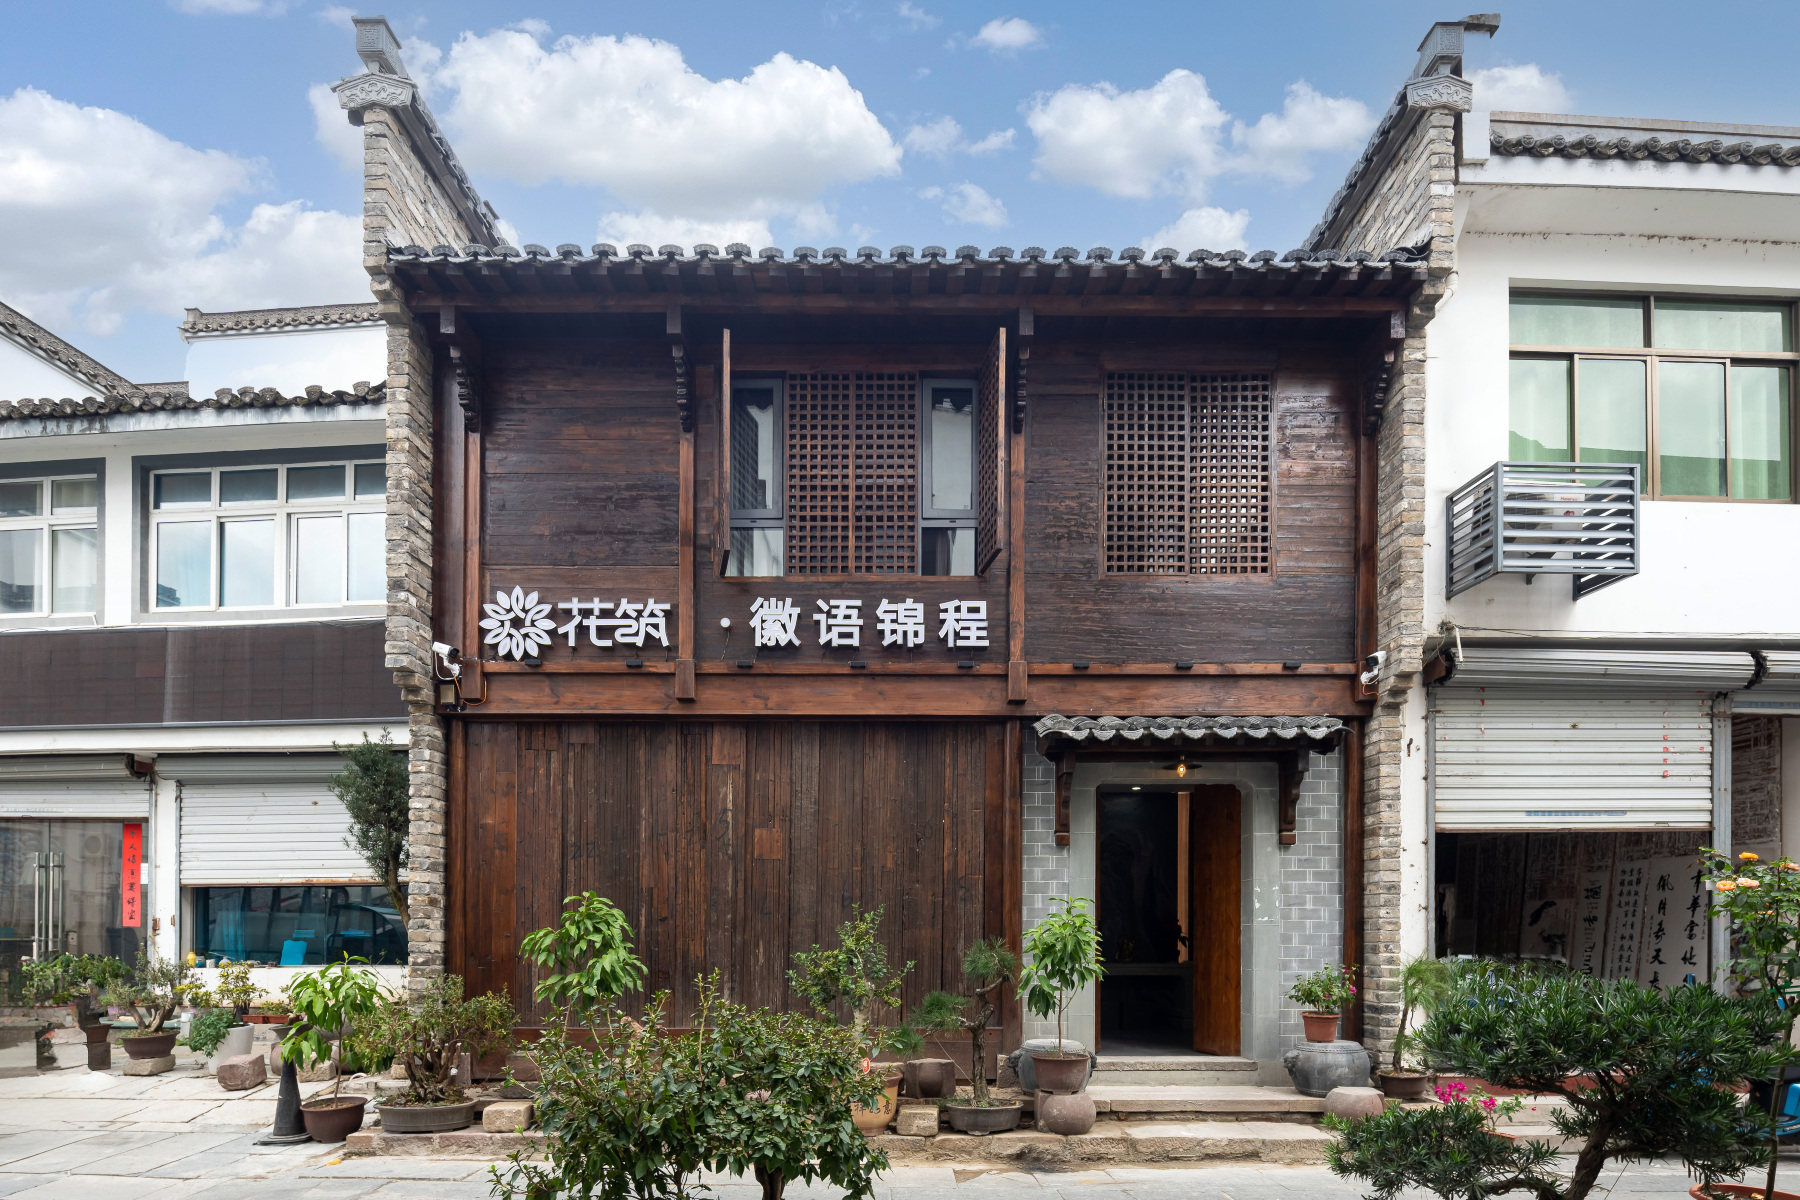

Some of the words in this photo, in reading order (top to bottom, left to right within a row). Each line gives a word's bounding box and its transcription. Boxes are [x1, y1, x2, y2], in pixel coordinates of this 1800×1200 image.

[557, 597, 671, 647] 花筑
[749, 597, 990, 648] 徽语锦程
